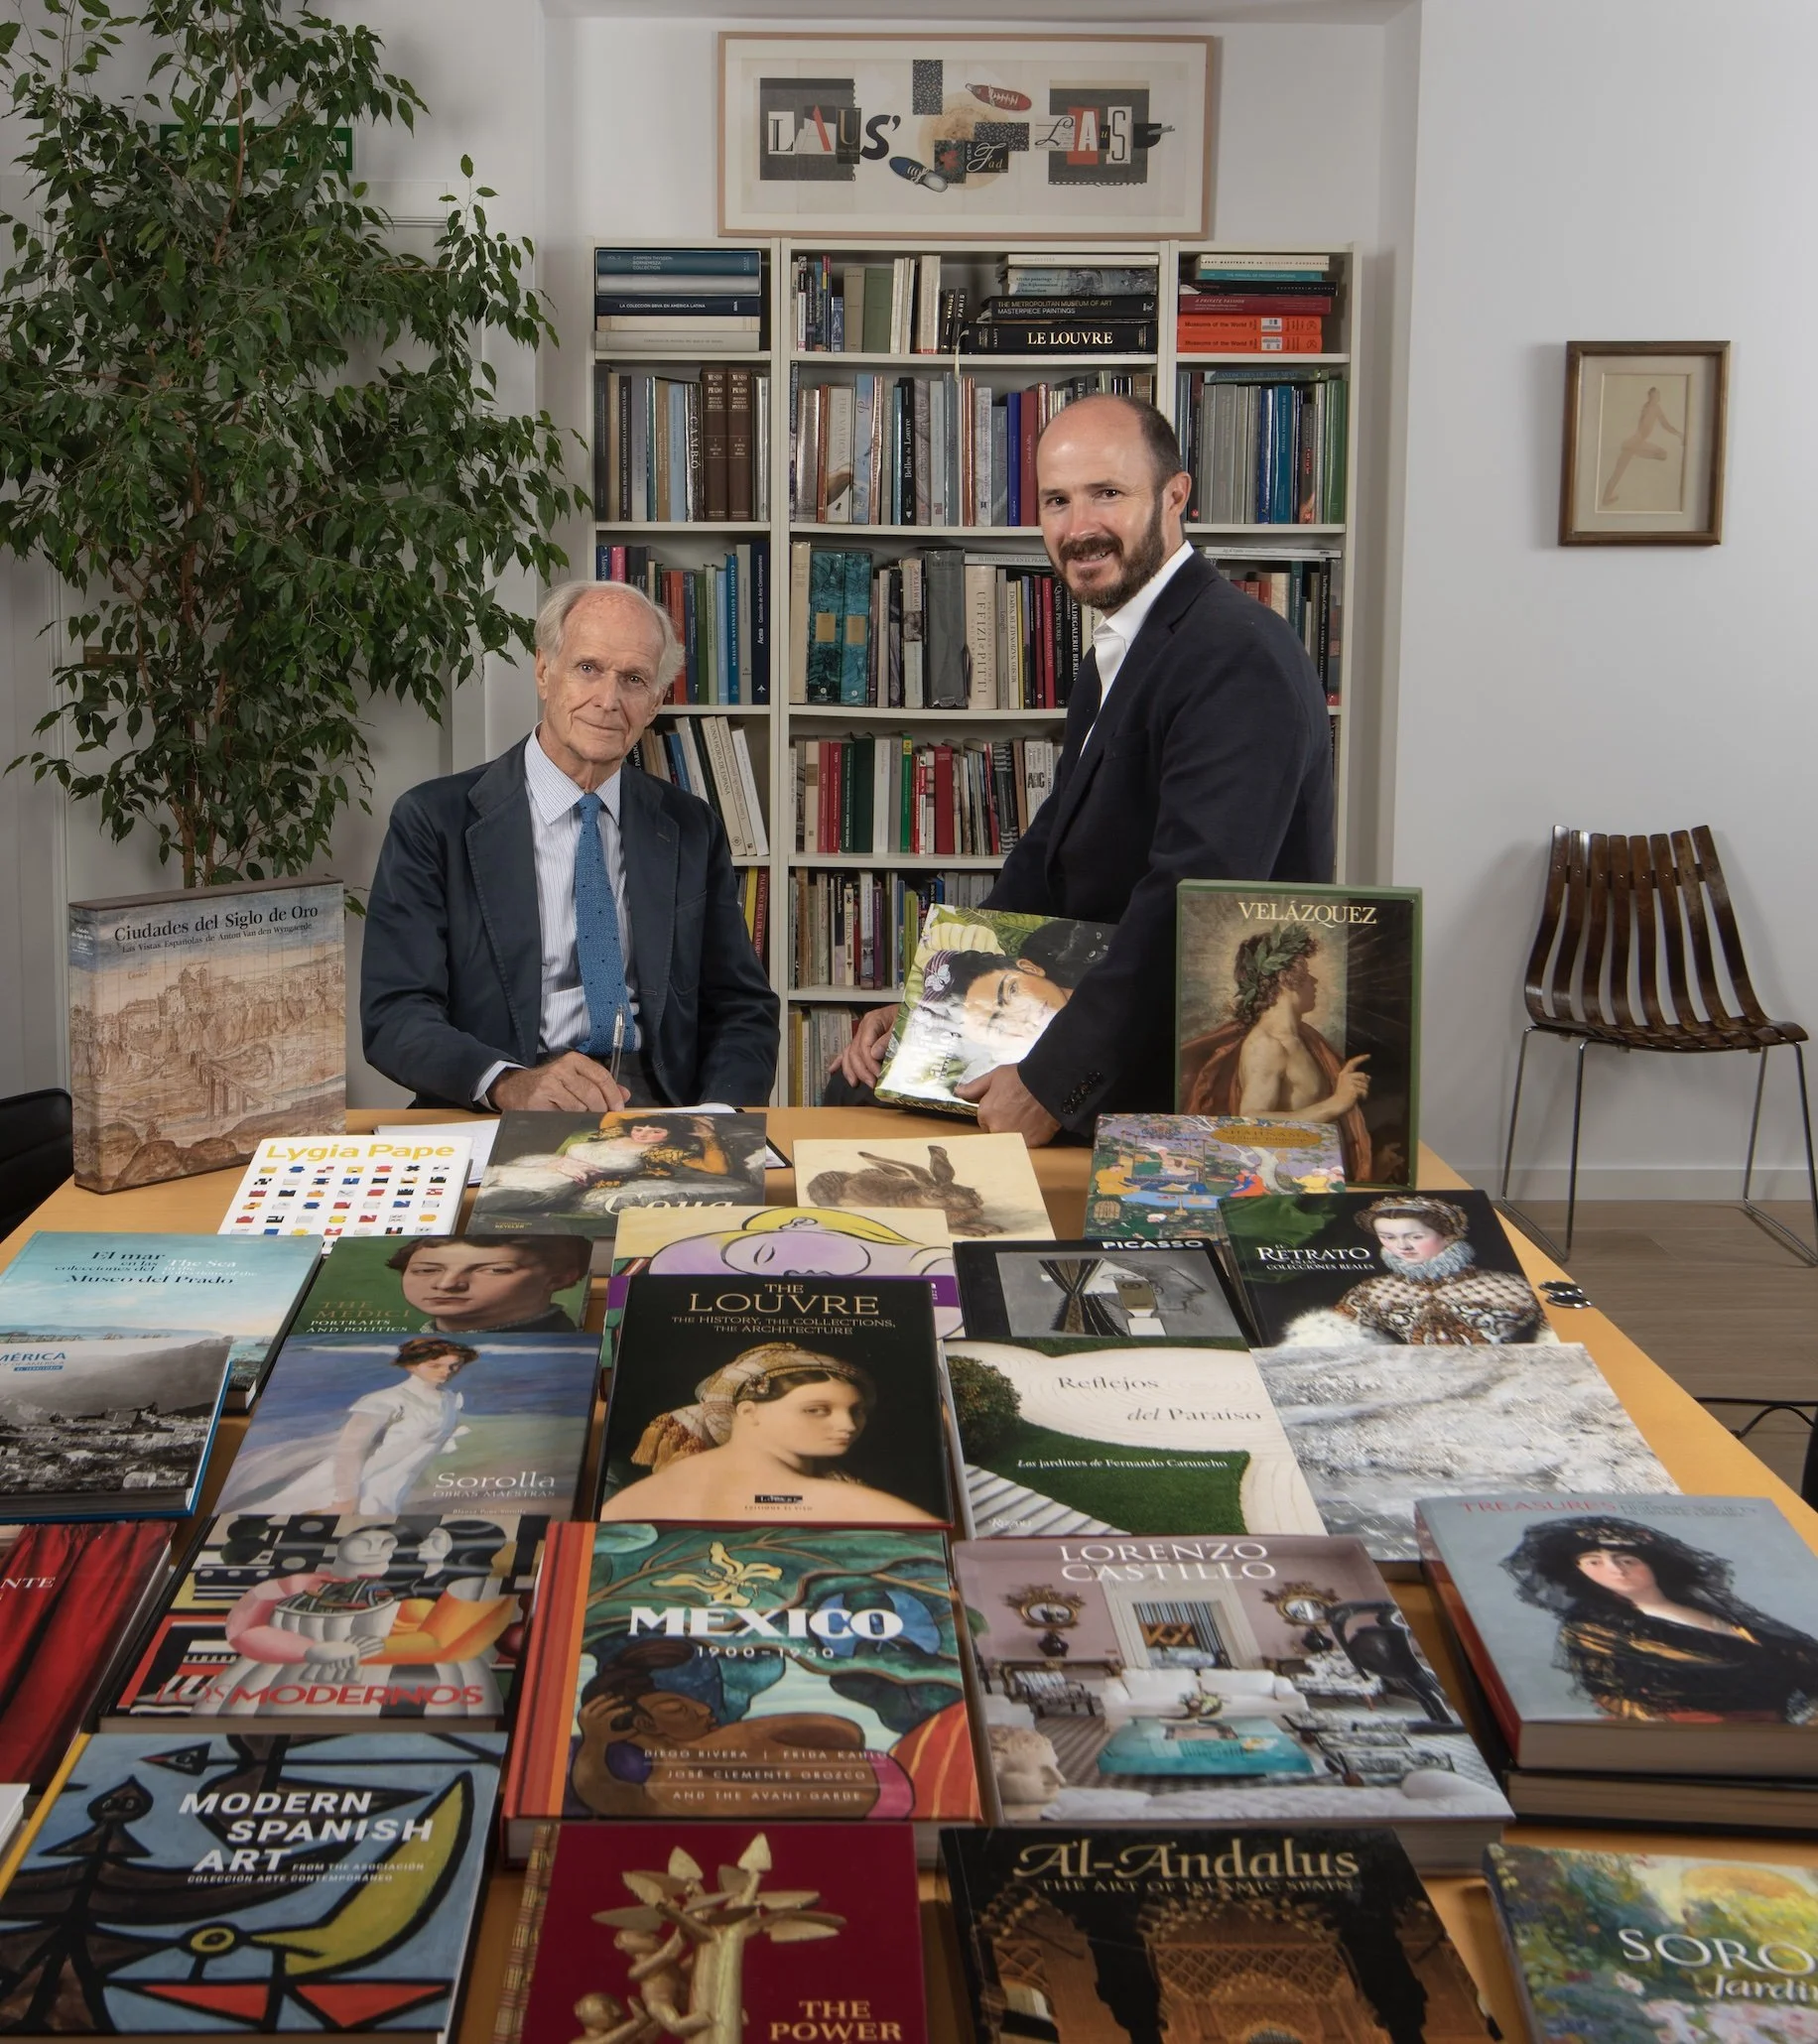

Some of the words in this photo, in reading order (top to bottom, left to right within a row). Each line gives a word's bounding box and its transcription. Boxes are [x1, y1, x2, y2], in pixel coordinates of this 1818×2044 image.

[1027, 331, 1047, 345] LE
[1049, 331, 1113, 345] LOUVRE
[977, 652, 986, 694] PITTI
[1238, 900, 1377, 929] VELÁZQUEZ
[114, 922, 190, 942] Ciudades
[195, 914, 218, 933] del
[224, 910, 263, 931] Siglo
[269, 907, 288, 923] de
[291, 905, 319, 919] Oro
[122, 945, 136, 954] Las
[139, 943, 162, 953] Vistas
[164, 936, 203, 950] Españolas
[258, 927, 272, 936] den
[266, 1143, 361, 1162] Lygia
[368, 1142, 455, 1161] Pape
[1102, 1240, 1205, 1250] PICASSO
[91, 1251, 116, 1260] El
[1255, 1246, 1370, 1262] RETRATO
[764, 1284, 805, 1294] THE
[688, 1293, 879, 1316] LOUVRE
[699, 1316, 762, 1326] HISTORY,
[793, 1318, 897, 1329] COLLECTIONS,
[741, 1326, 853, 1336] ARCHITECTURE
[1058, 1375, 1159, 1391] Reflejos
[1126, 1406, 1160, 1421] del
[1039, 1459, 1088, 1469] jardines
[1104, 1460, 1165, 1469] Fernando
[1166, 1460, 1230, 1469] Caruncho
[435, 1470, 556, 1488] Sorolla
[1459, 1499, 1618, 1514] TREASURES
[1059, 1542, 1268, 1563] LORENZO
[1061, 1563, 1277, 1582] CASTILLO
[628, 1606, 903, 1639] MEXICO
[696, 1646, 836, 1659] 1900-1950
[644, 1749, 691, 1759] DIEGO
[698, 1749, 748, 1759] RIVERA
[783, 1750, 827, 1760] FRIDA
[837, 1751, 888, 1760] KAHLO
[668, 1768, 704, 1779] JOSÉ
[714, 1770, 791, 1780] CLEMENTE
[800, 1770, 865, 1780] OROZCO
[178, 1791, 372, 1815] MODERN
[673, 1791, 706, 1801] AND
[714, 1791, 741, 1801] THE
[750, 1791, 861, 1801] AVANT-GARDE
[226, 1819, 434, 1843] SPANISH
[193, 1849, 292, 1873] ART
[353, 1862, 425, 1871] ASOCIACIÓN
[1013, 1839, 1360, 1879] Al-Andalus
[187, 1874, 252, 1883] COLECCIÓN
[290, 1873, 393, 1883] CONTEMPORÁNEO
[1043, 1879, 1087, 1891] THE
[1094, 1879, 1139, 1892] ART
[1145, 1880, 1177, 1892] OF
[1618, 1928, 1816, 1976] SORO
[799, 2000, 870, 2020] THE
[769, 2022, 902, 2042] POWER
